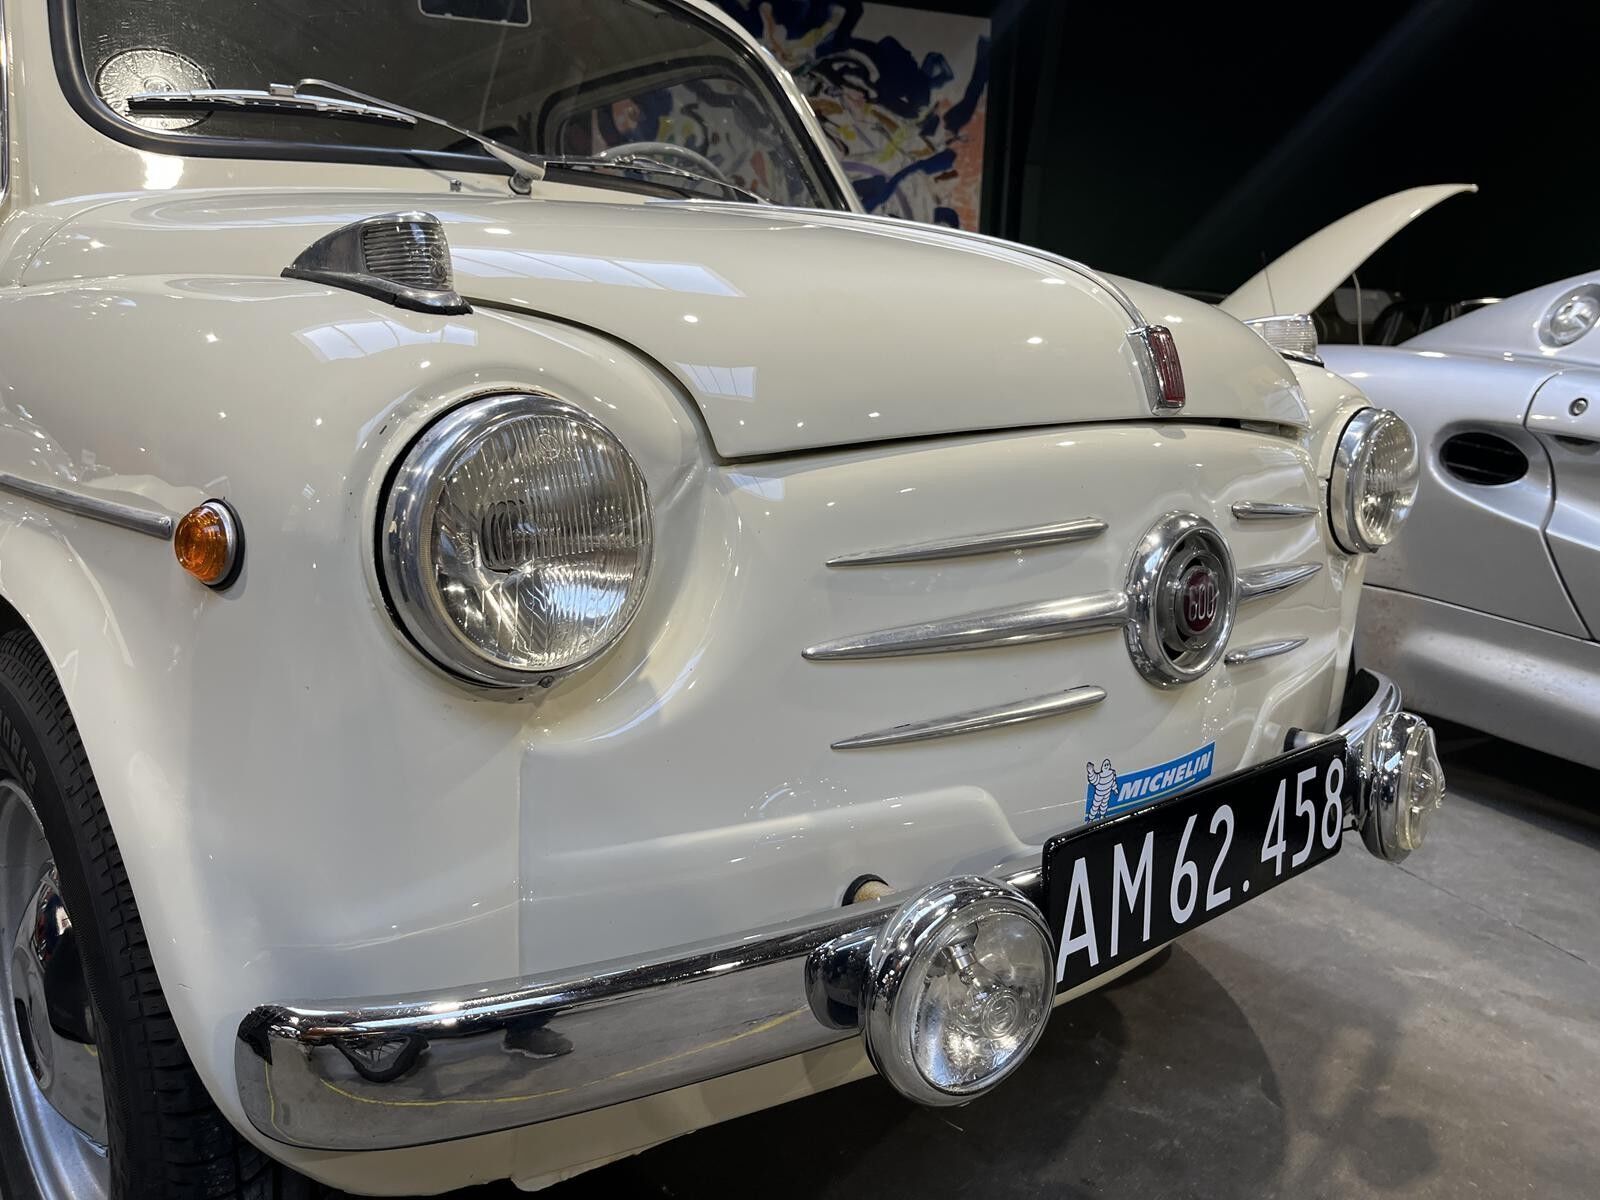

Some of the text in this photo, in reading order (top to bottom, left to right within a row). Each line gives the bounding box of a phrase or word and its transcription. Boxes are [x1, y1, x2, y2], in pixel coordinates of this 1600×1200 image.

[1188, 582, 1214, 621] 600
[1117, 751, 1211, 802] MICHELIN
[1056, 758, 1344, 984] AM 62.458
